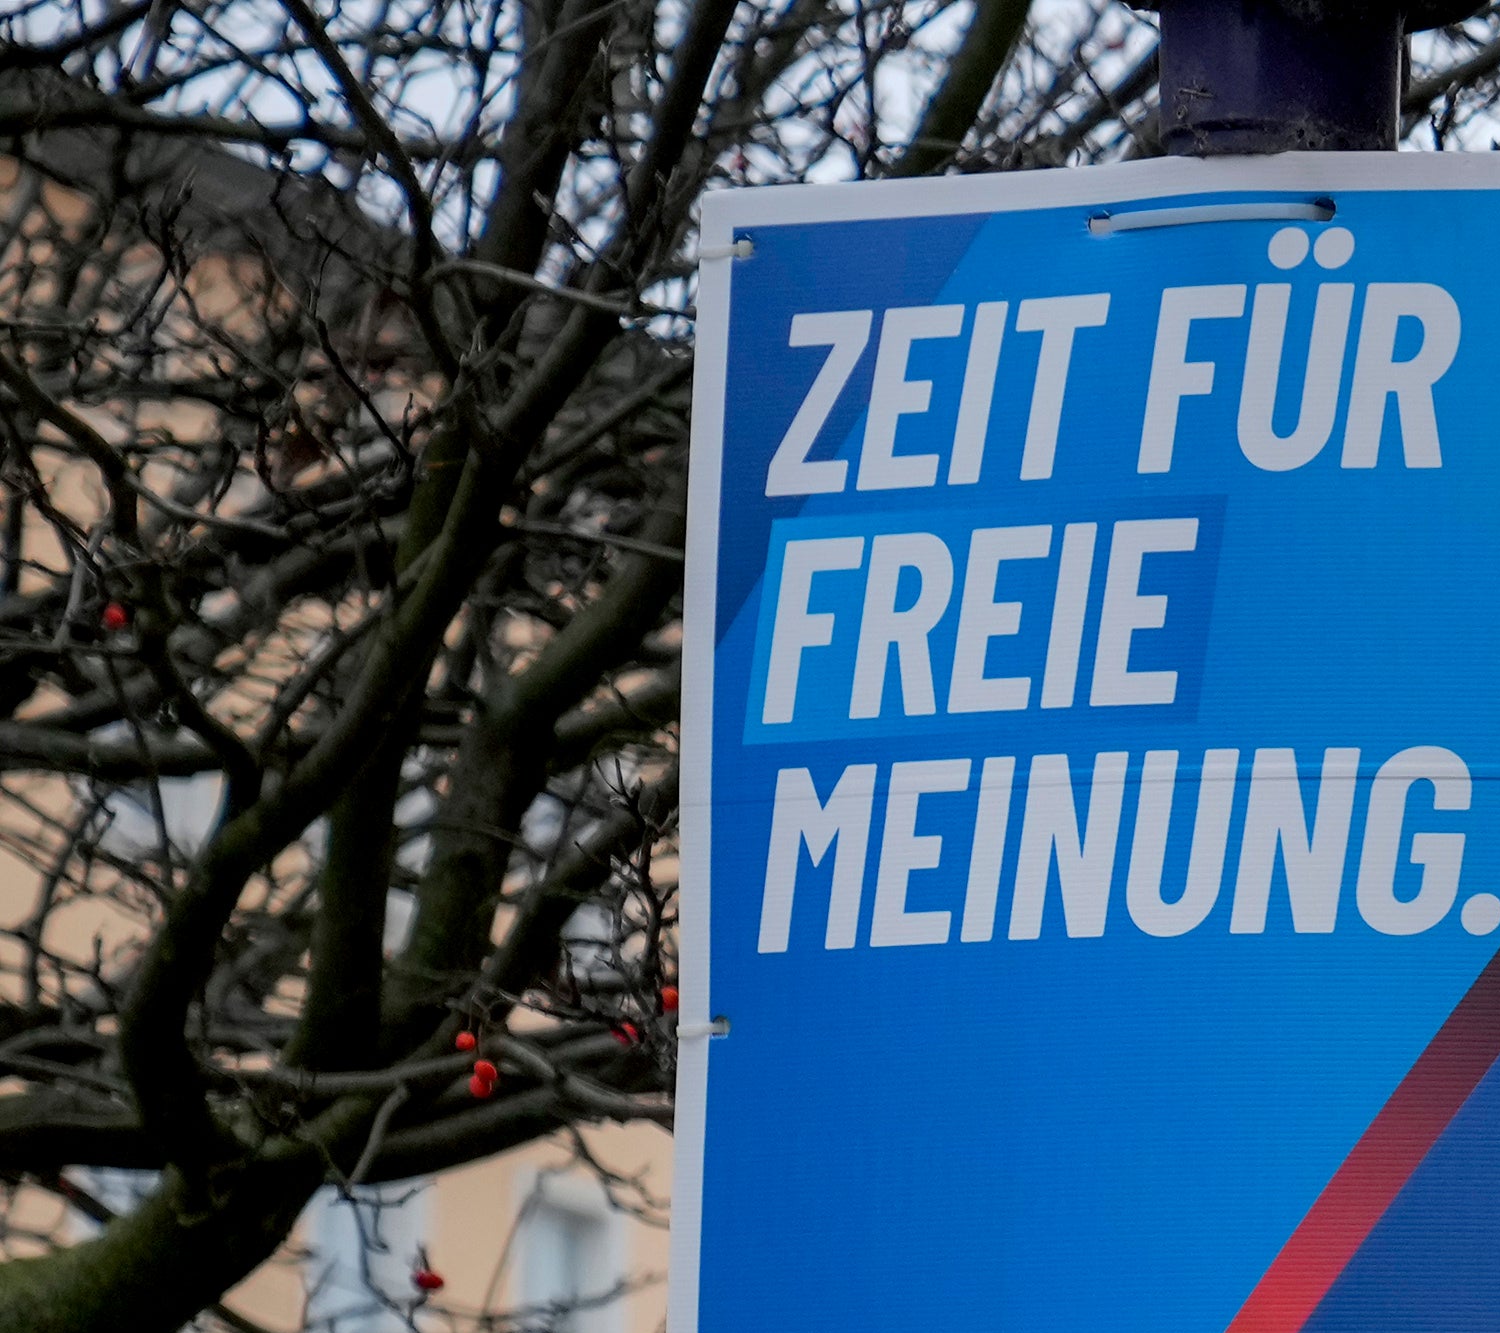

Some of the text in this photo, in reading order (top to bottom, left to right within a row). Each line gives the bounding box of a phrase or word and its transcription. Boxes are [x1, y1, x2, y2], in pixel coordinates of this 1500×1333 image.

[765, 229, 1463, 497] ZEIT FÜR
[762, 517, 1200, 725] FREIE
